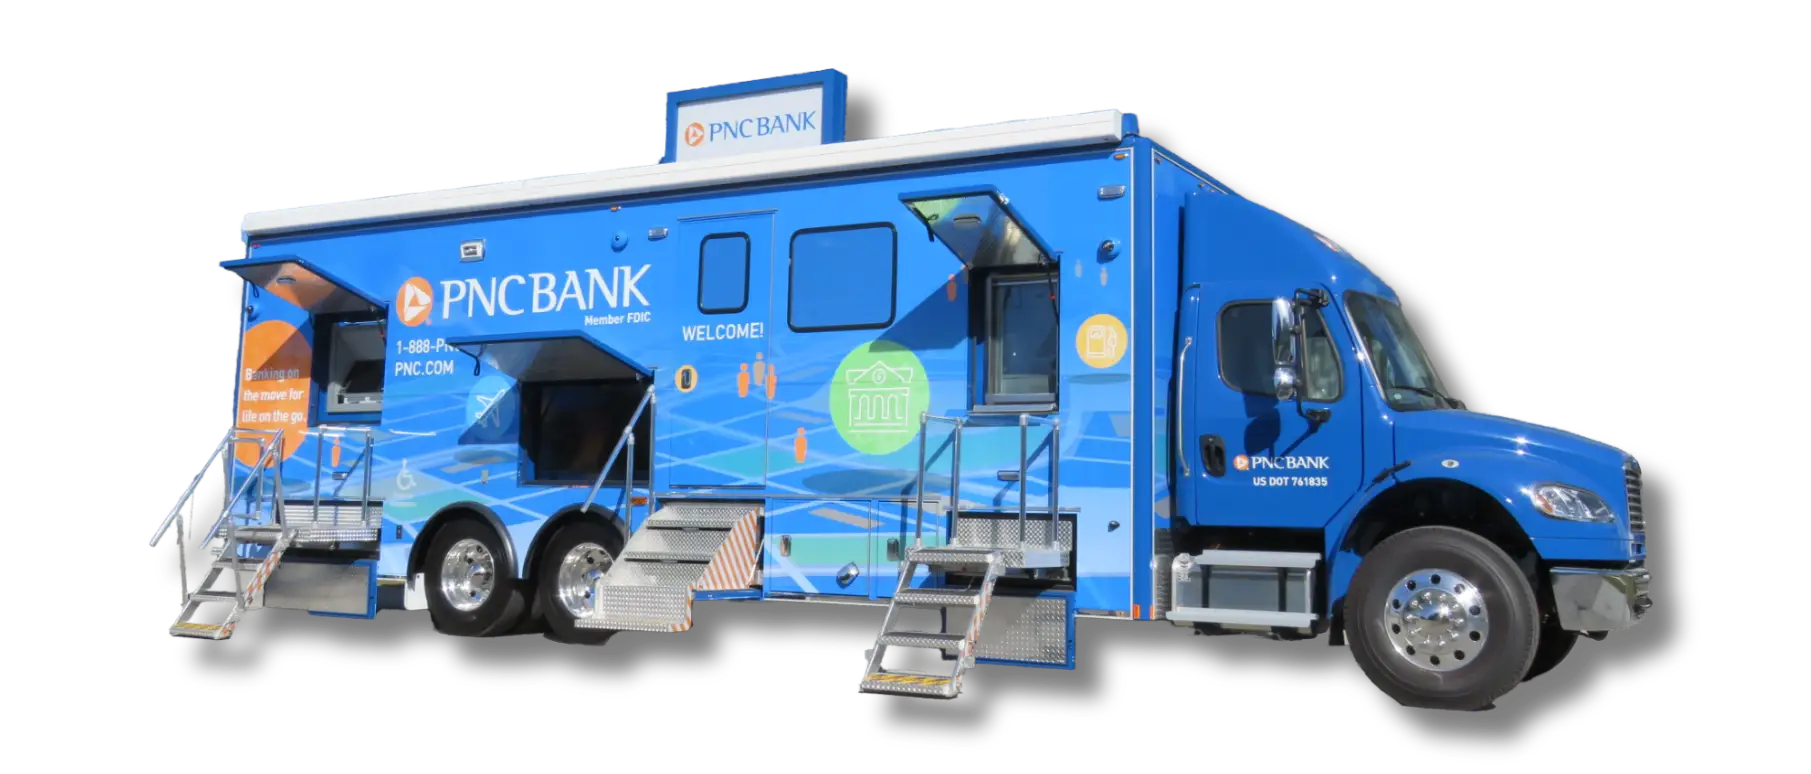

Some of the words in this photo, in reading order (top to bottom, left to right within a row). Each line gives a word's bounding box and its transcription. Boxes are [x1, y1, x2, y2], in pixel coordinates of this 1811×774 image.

[709, 118, 753, 142] PNC
[756, 110, 816, 136] BANK
[440, 275, 526, 320] PNC
[528, 264, 651, 313] BANK
[584, 314, 625, 326] Member
[627, 311, 651, 323] FDIC
[682, 322, 764, 341] WELCOME!
[245, 367, 285, 382] Banking
[287, 369, 300, 379] on
[395, 360, 454, 376] PNC.COM
[244, 389, 259, 402] the
[260, 391, 288, 401] move
[289, 388, 304, 400] for
[242, 409, 257, 422] life
[259, 412, 271, 422] on
[272, 410, 289, 421] the
[291, 411, 306, 424] go.
[1250, 456, 1284, 469] PNC
[1285, 456, 1329, 469] BANK
[1253, 476, 1267, 487] US
[1269, 477, 1289, 487] DOT
[1291, 476, 1328, 487] 761835
